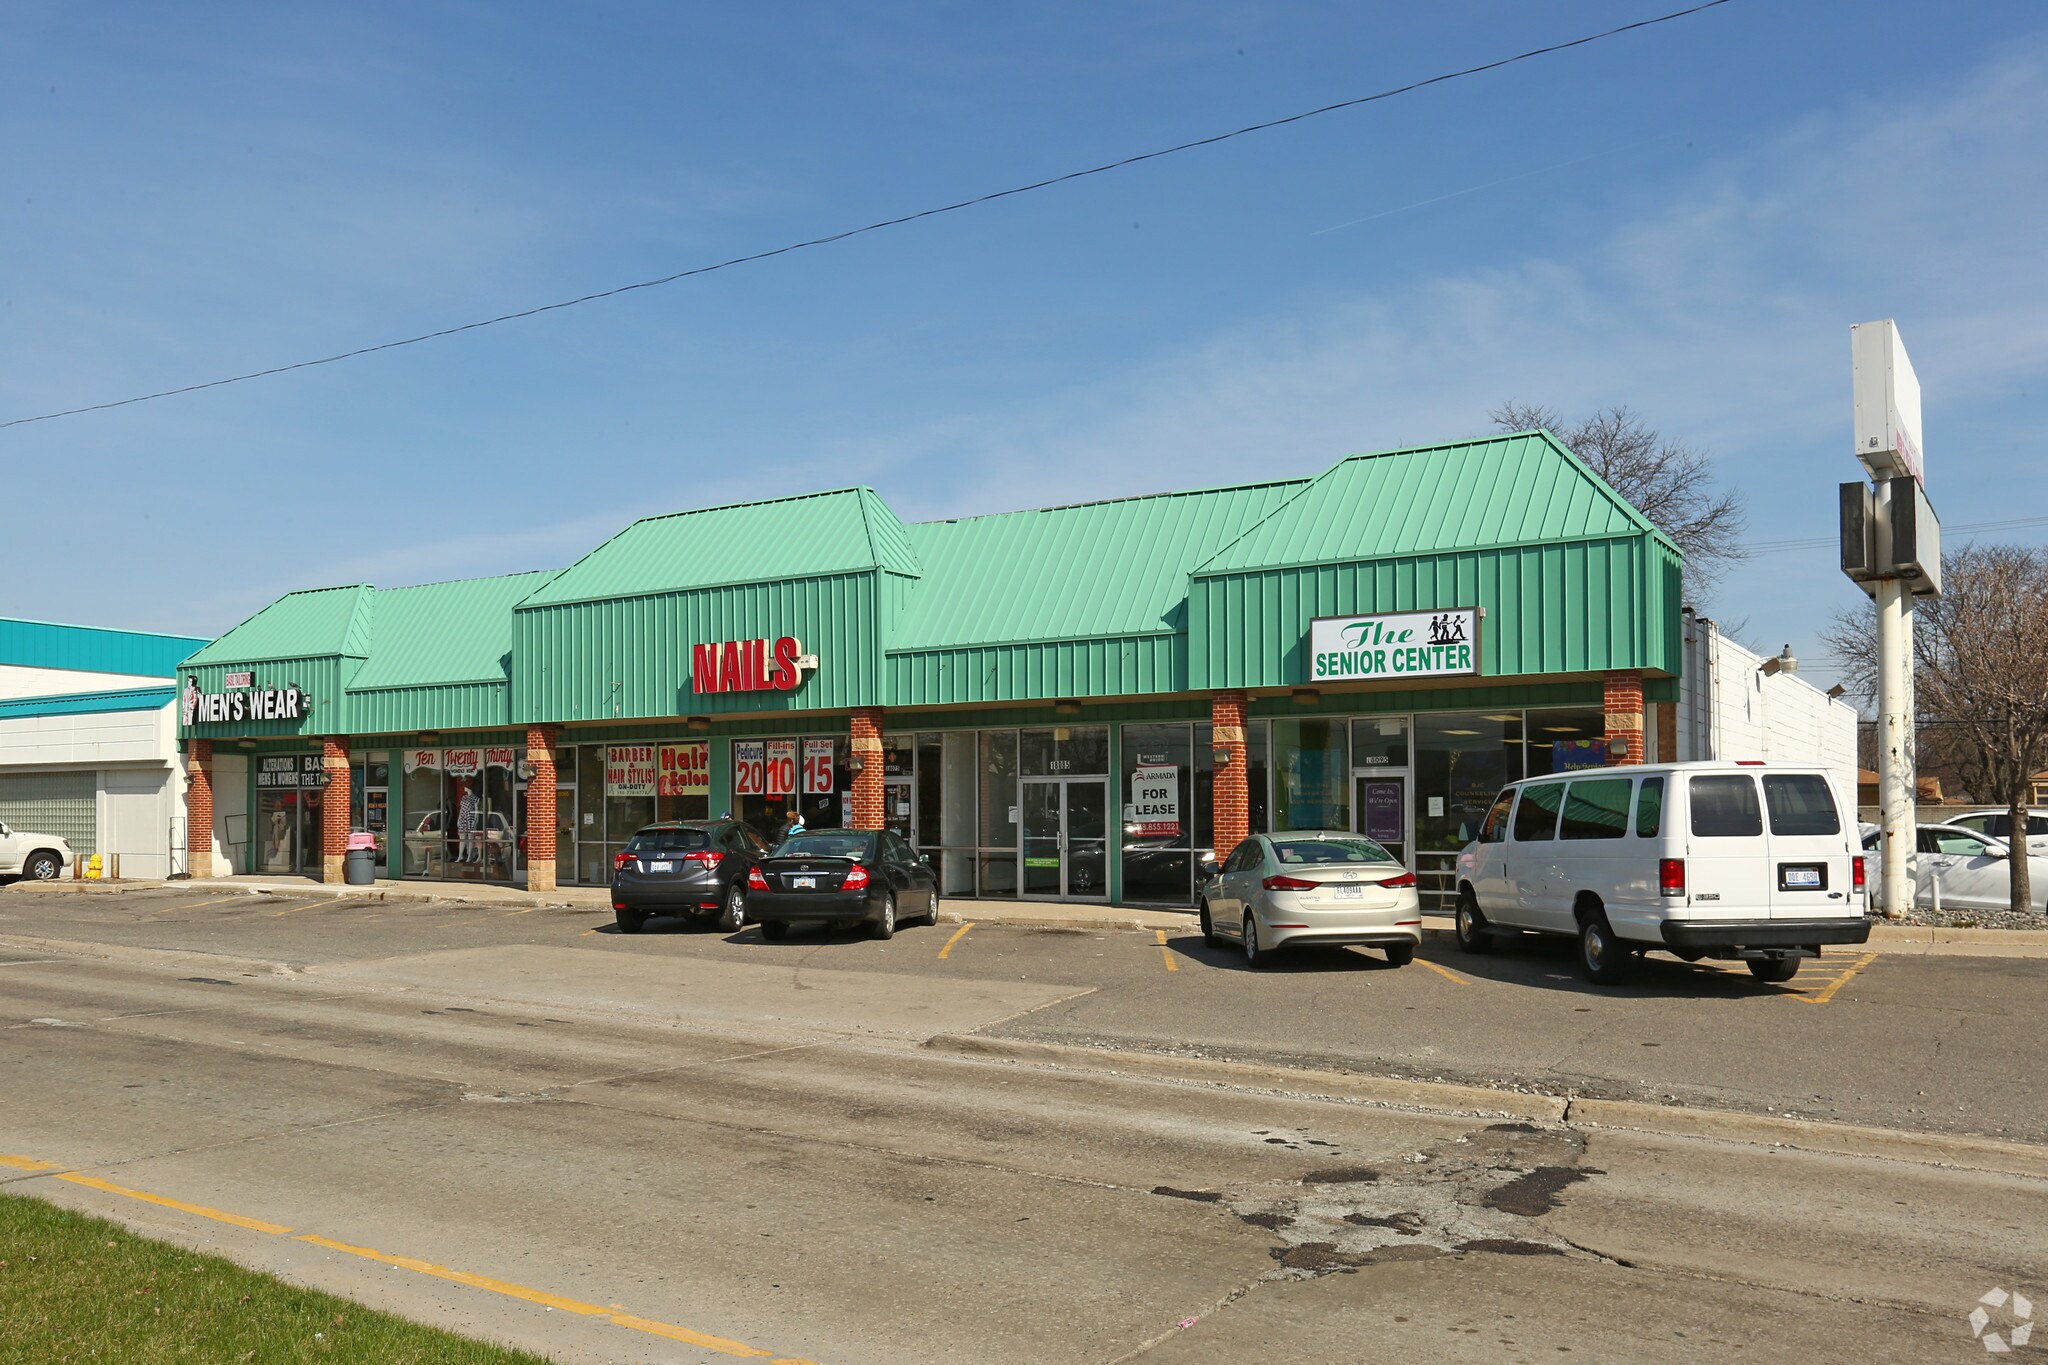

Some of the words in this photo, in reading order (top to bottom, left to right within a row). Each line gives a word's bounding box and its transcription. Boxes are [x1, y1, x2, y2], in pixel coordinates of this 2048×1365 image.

[1340, 621, 1416, 649] The
[693, 636, 801, 694] NAILS
[1316, 650, 1386, 676] SENIOR
[1392, 645, 1472, 672] CENTER
[198, 692, 244, 722] MEN'S
[250, 689, 298, 720] WEAR
[736, 744, 762, 760] Pedicure
[768, 742, 794, 750] Fill-ins
[416, 751, 435, 766] Ten
[445, 749, 478, 770] Twenty
[487, 748, 513, 768] Thirty
[611, 748, 652, 762] BARBER
[661, 747, 708, 770] Hair
[263, 758, 293, 771] ALTERATIONS
[305, 757, 324, 771] BAS
[258, 773, 271, 785] MENS
[272, 773, 276, 785] &
[277, 772, 298, 784] WOMENS
[301, 774, 315, 785] THE
[608, 769, 625, 783] HAIR
[628, 768, 655, 784] STYLIST
[670, 771, 708, 786] Salon
[1146, 772, 1176, 780] ARMADA
[1142, 789, 1168, 799] FOR
[1136, 804, 1175, 815] LEASE
